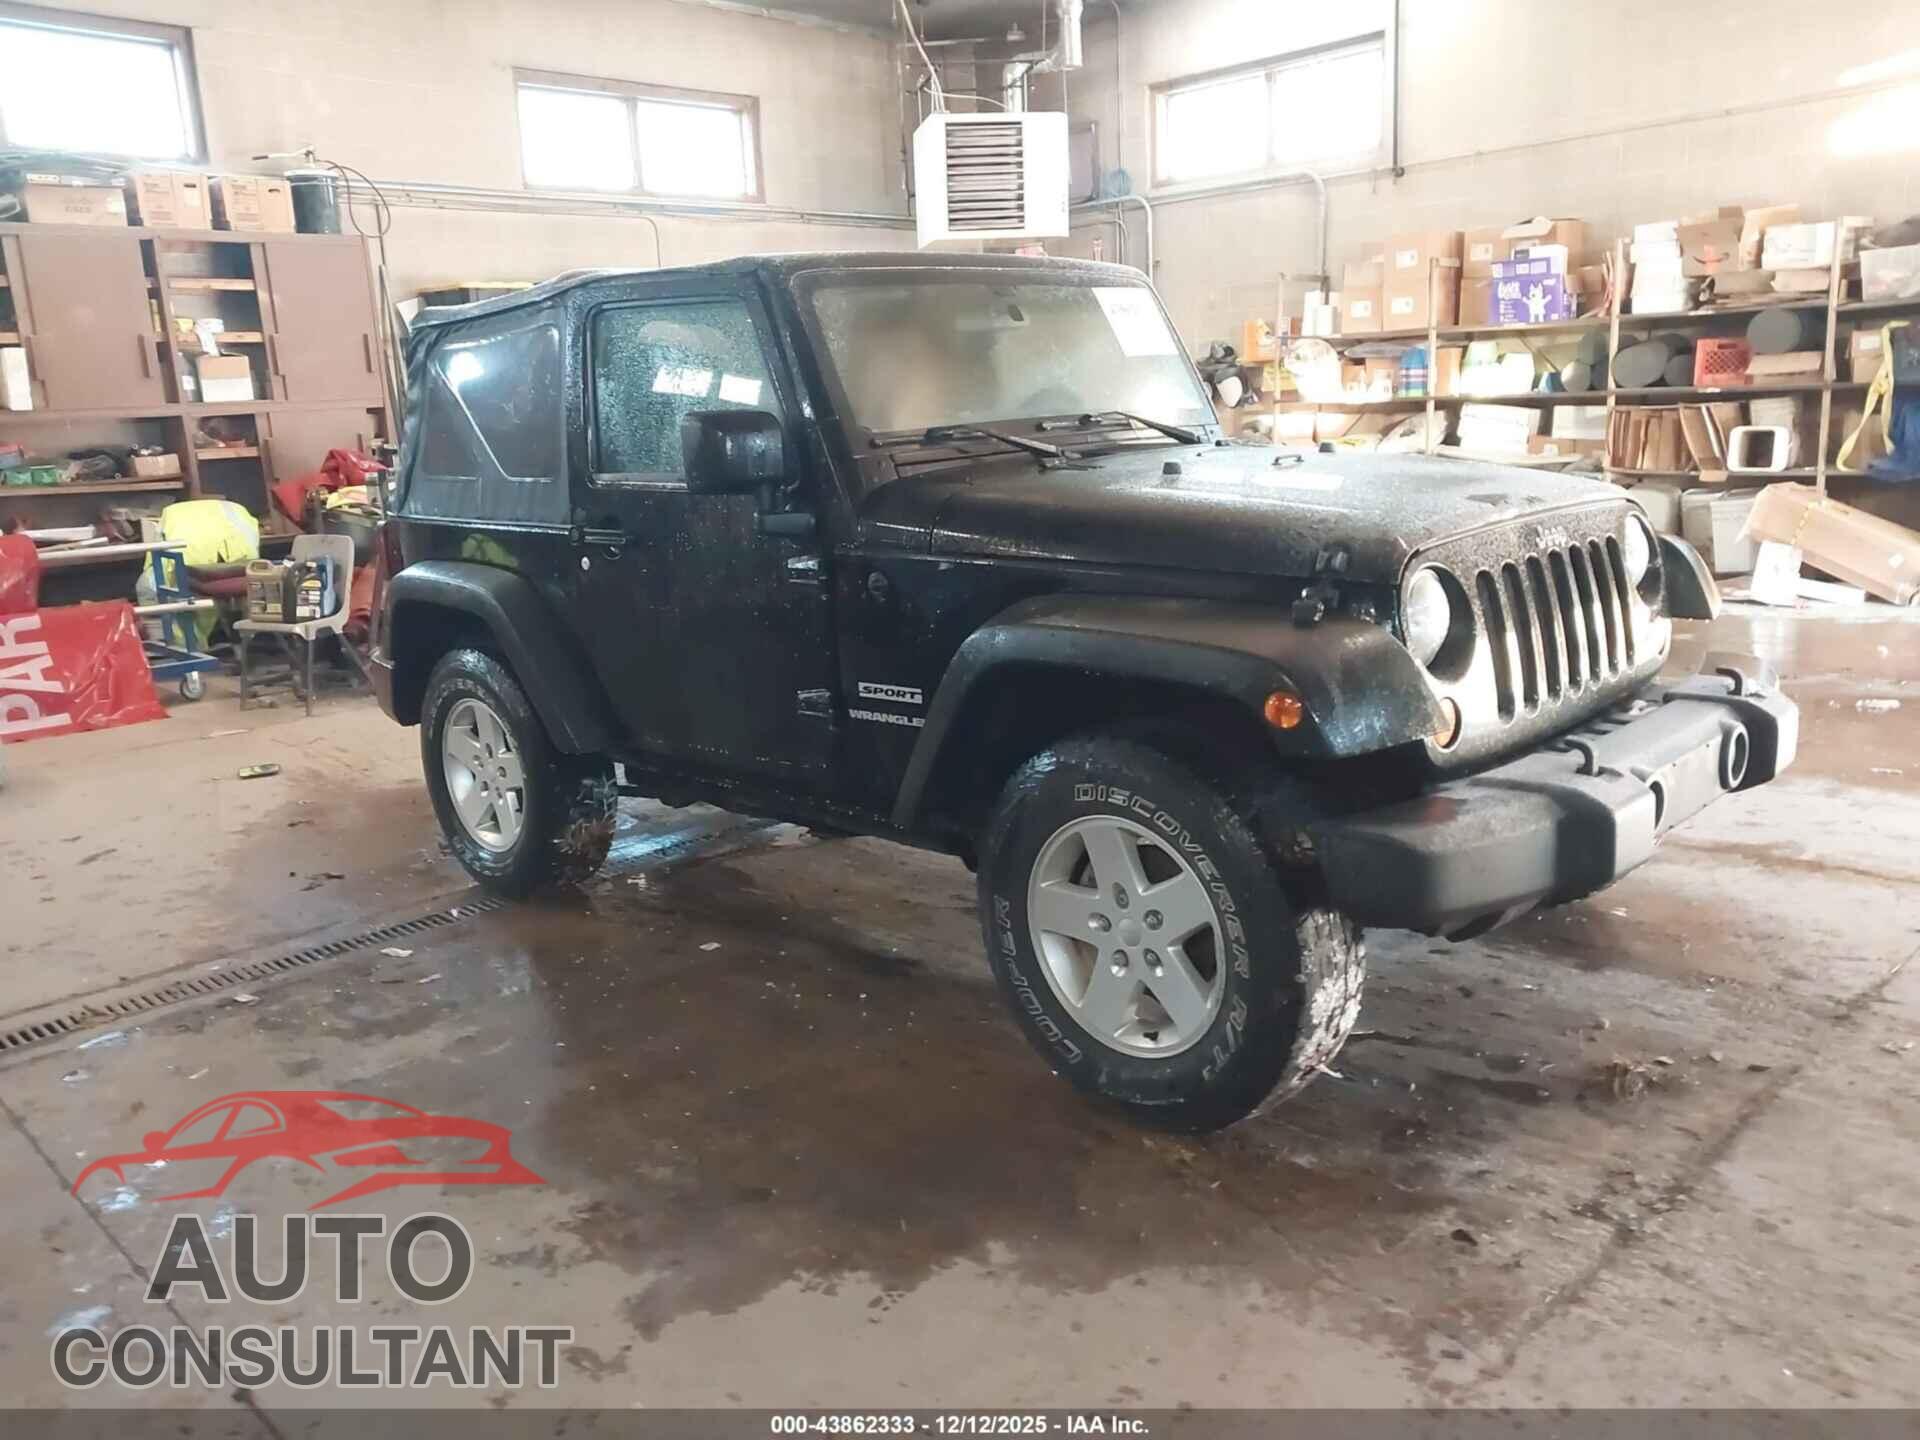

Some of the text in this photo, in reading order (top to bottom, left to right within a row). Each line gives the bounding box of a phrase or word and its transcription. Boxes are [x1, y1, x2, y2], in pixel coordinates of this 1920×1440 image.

[1535, 524, 1568, 549] Jeep
[861, 685, 922, 700] SPORT
[848, 709, 926, 727] WRANGLE
[1073, 782, 1251, 979] DISCOVERER
[992, 896, 1082, 1064] COOPER
